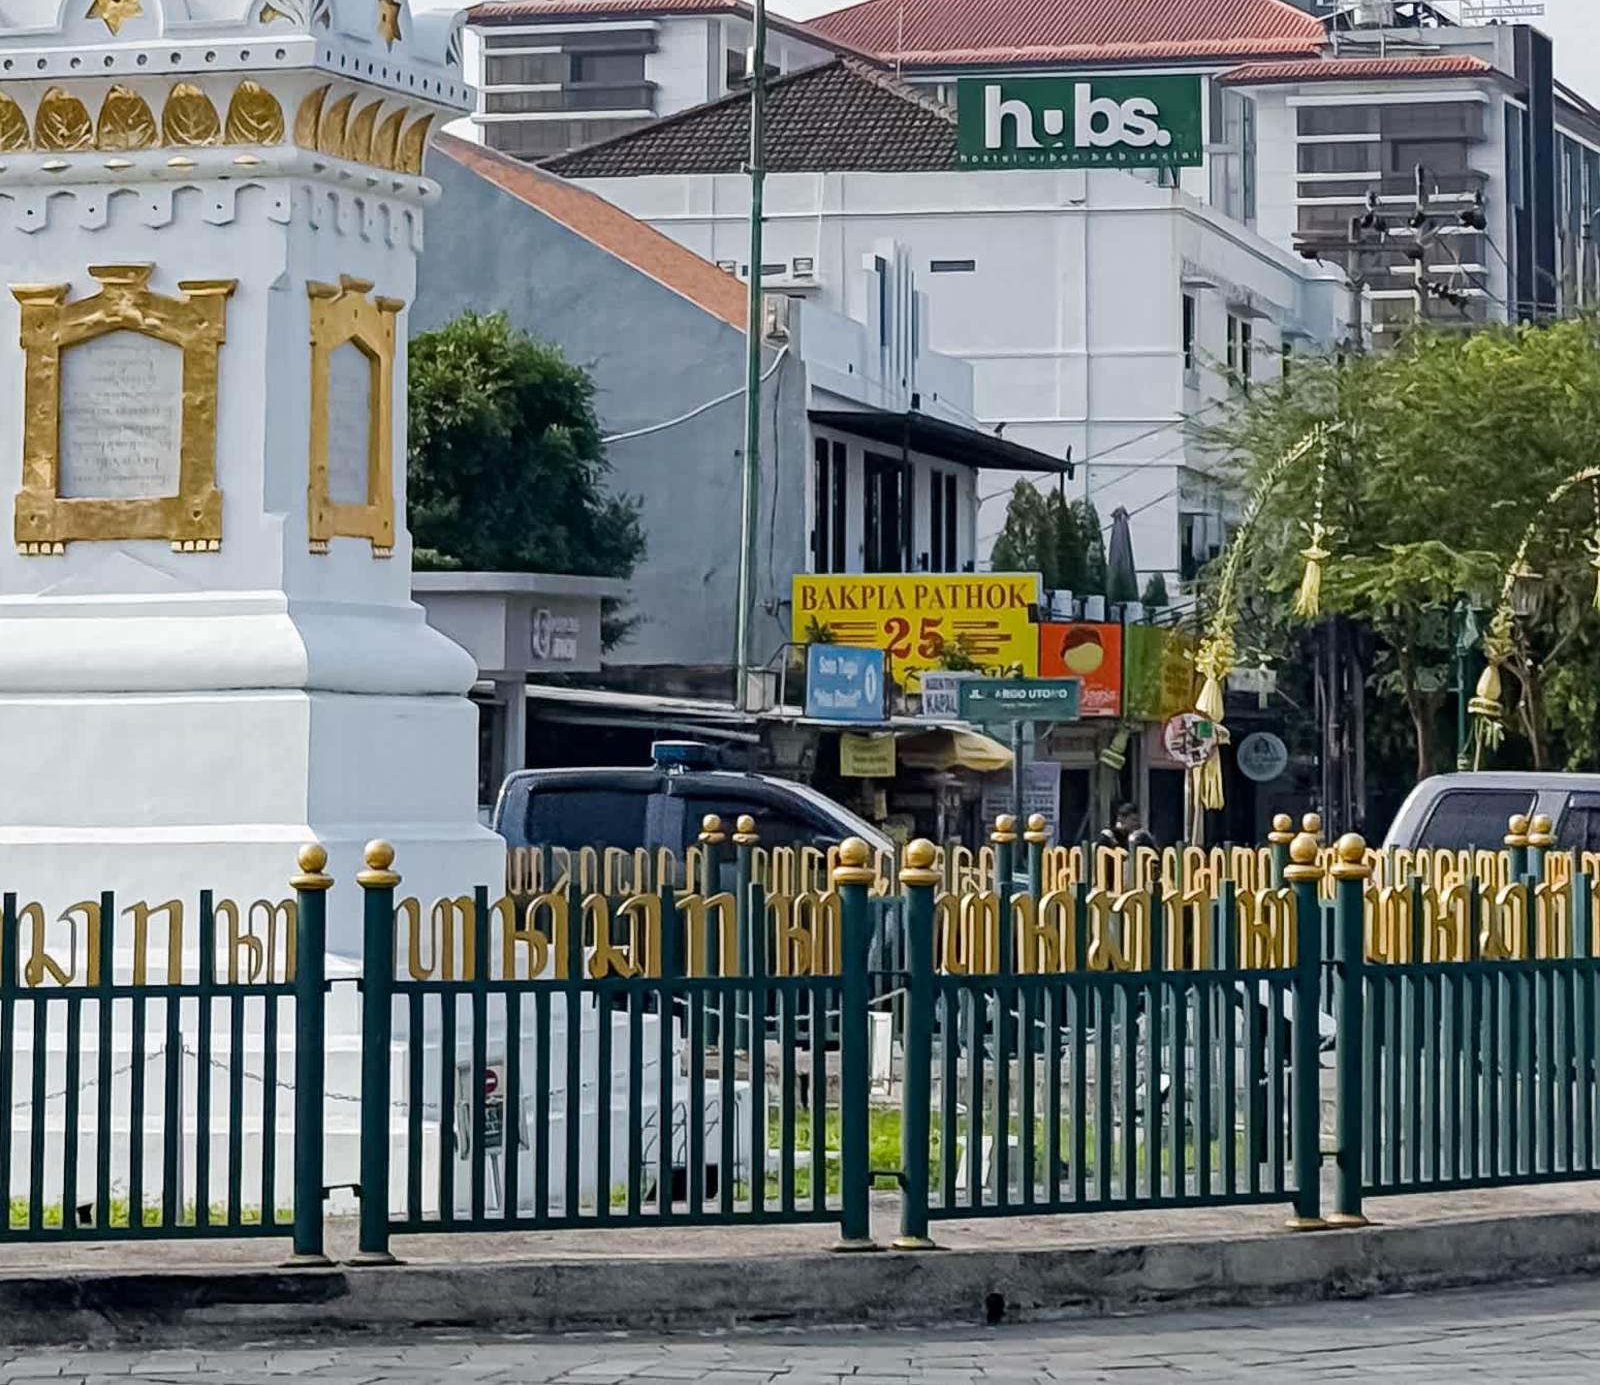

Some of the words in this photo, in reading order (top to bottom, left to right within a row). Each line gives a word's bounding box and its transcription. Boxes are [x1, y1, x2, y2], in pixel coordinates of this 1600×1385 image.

[801, 584, 904, 612] BAKPIA
[914, 583, 1029, 610] PATHOK
[884, 617, 945, 660] 25
